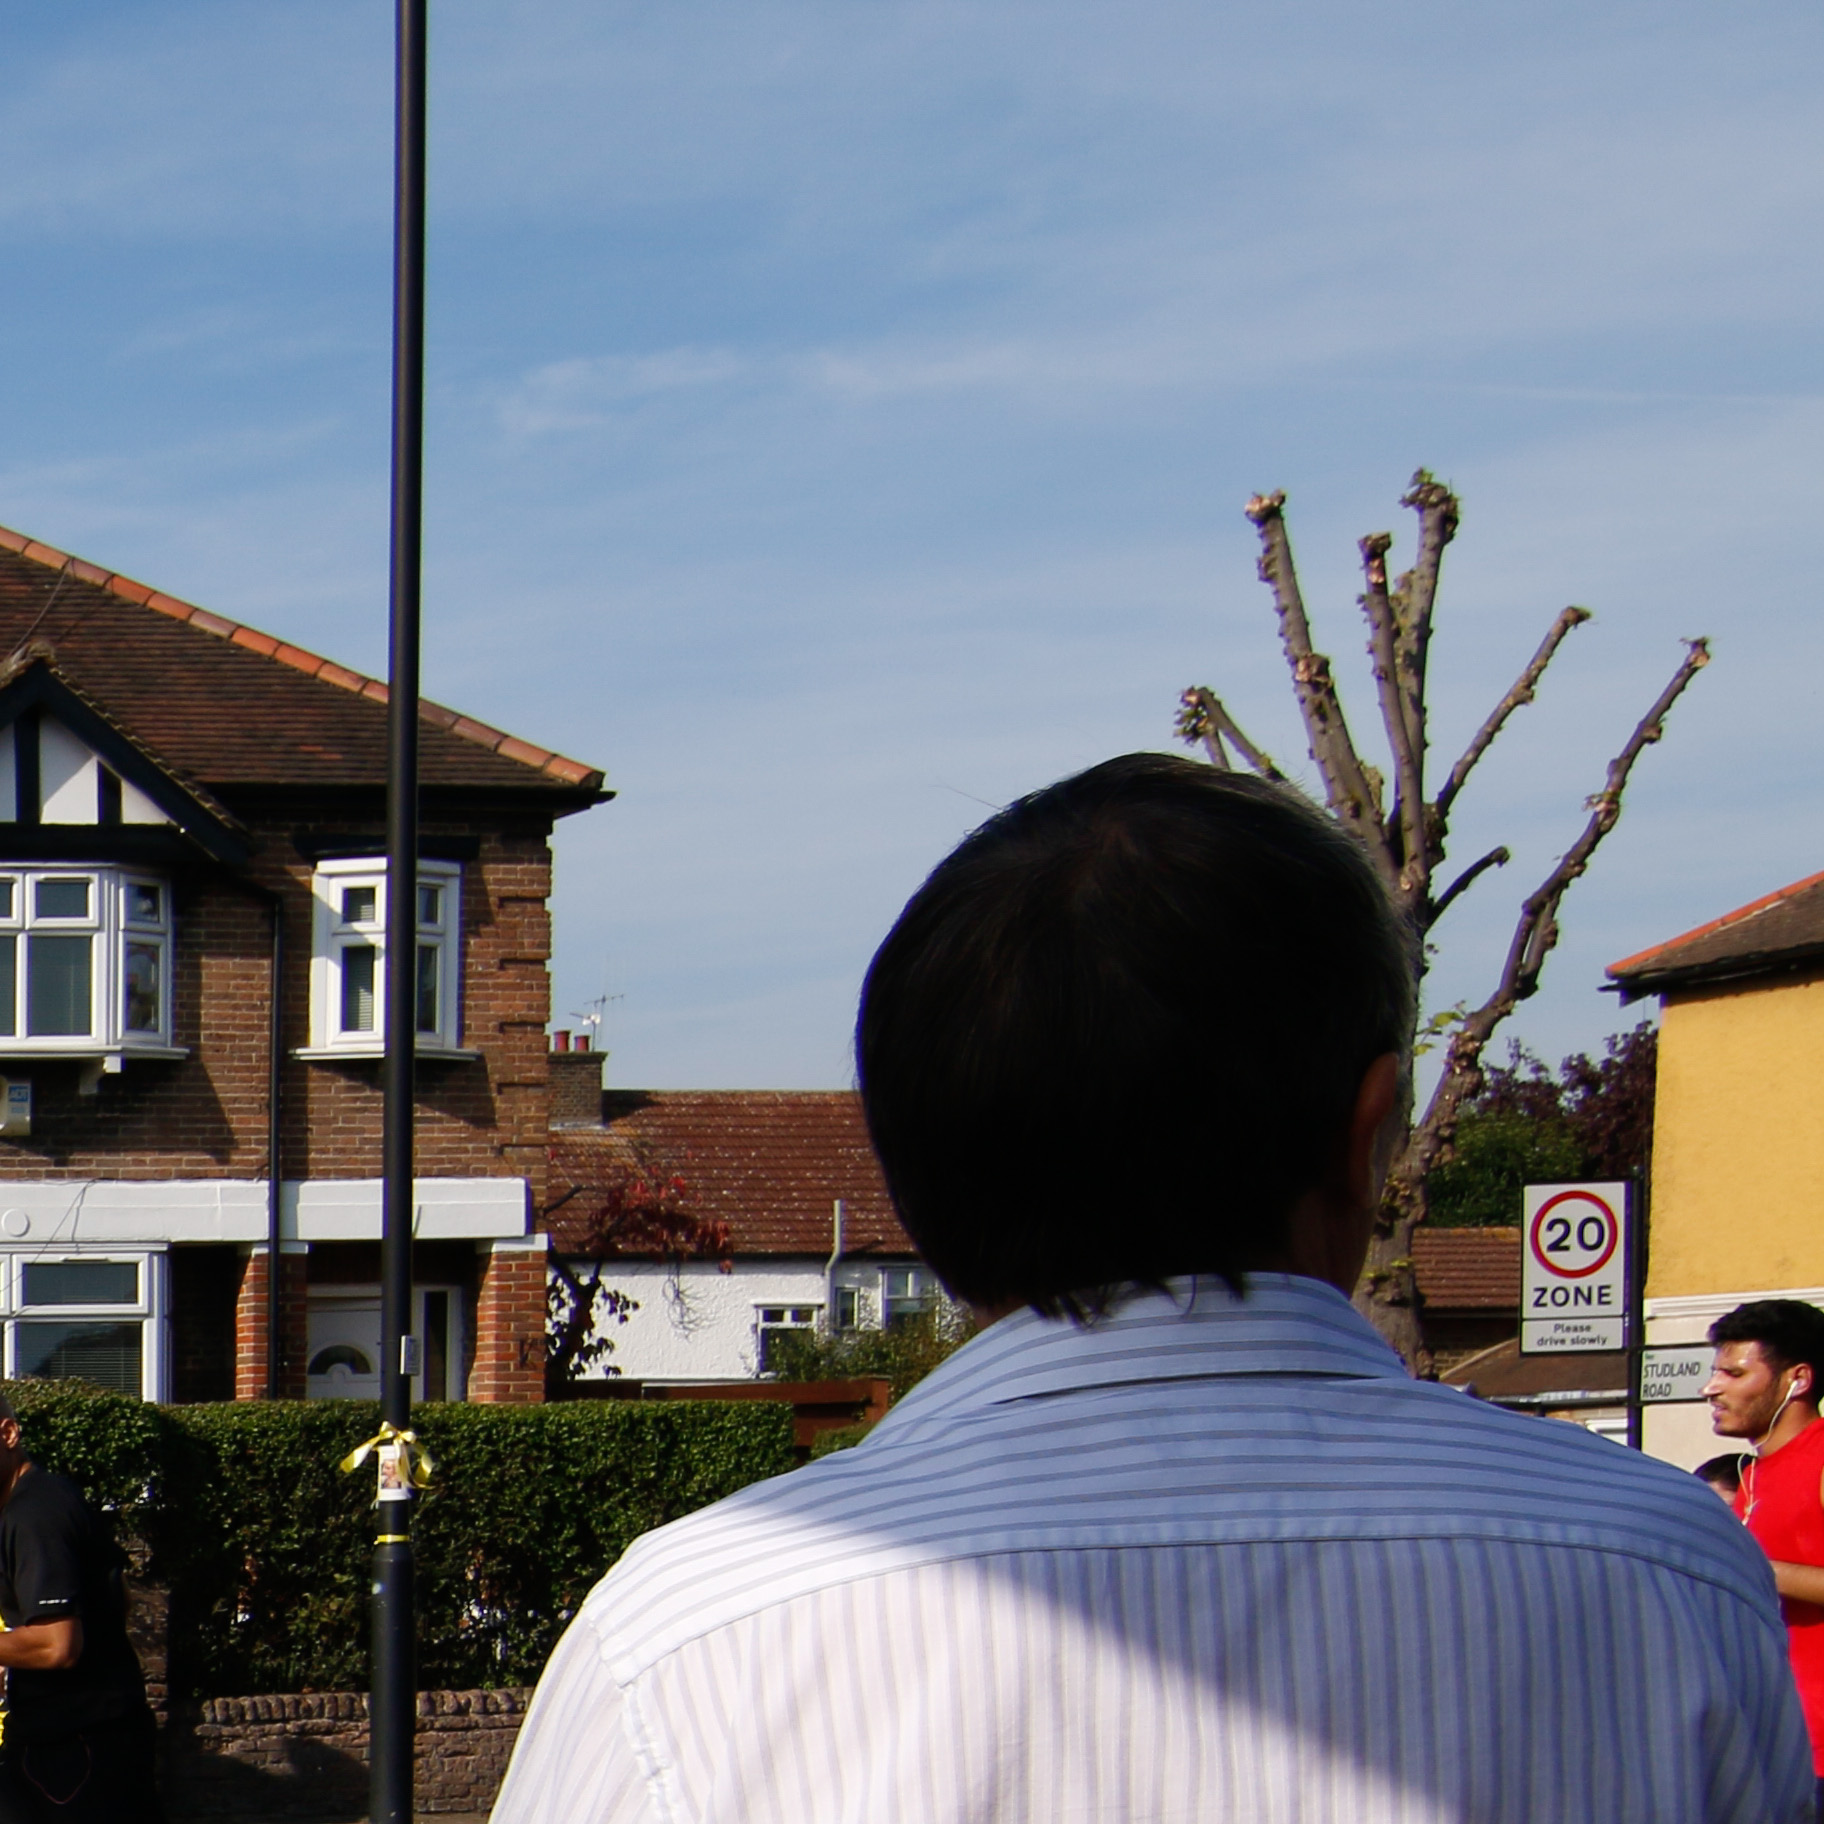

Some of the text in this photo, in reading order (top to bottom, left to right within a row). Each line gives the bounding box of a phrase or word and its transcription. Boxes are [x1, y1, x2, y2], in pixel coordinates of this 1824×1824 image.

[1545, 1216, 1605, 1253] 20
[1532, 1284, 1613, 1308] ZONE
[1554, 1323, 1591, 1333] Please
[1537, 1335, 1608, 1347] drive slowly
[1643, 1362, 1701, 1378] STUDLAND
[1643, 1383, 1672, 1397] ROAD
